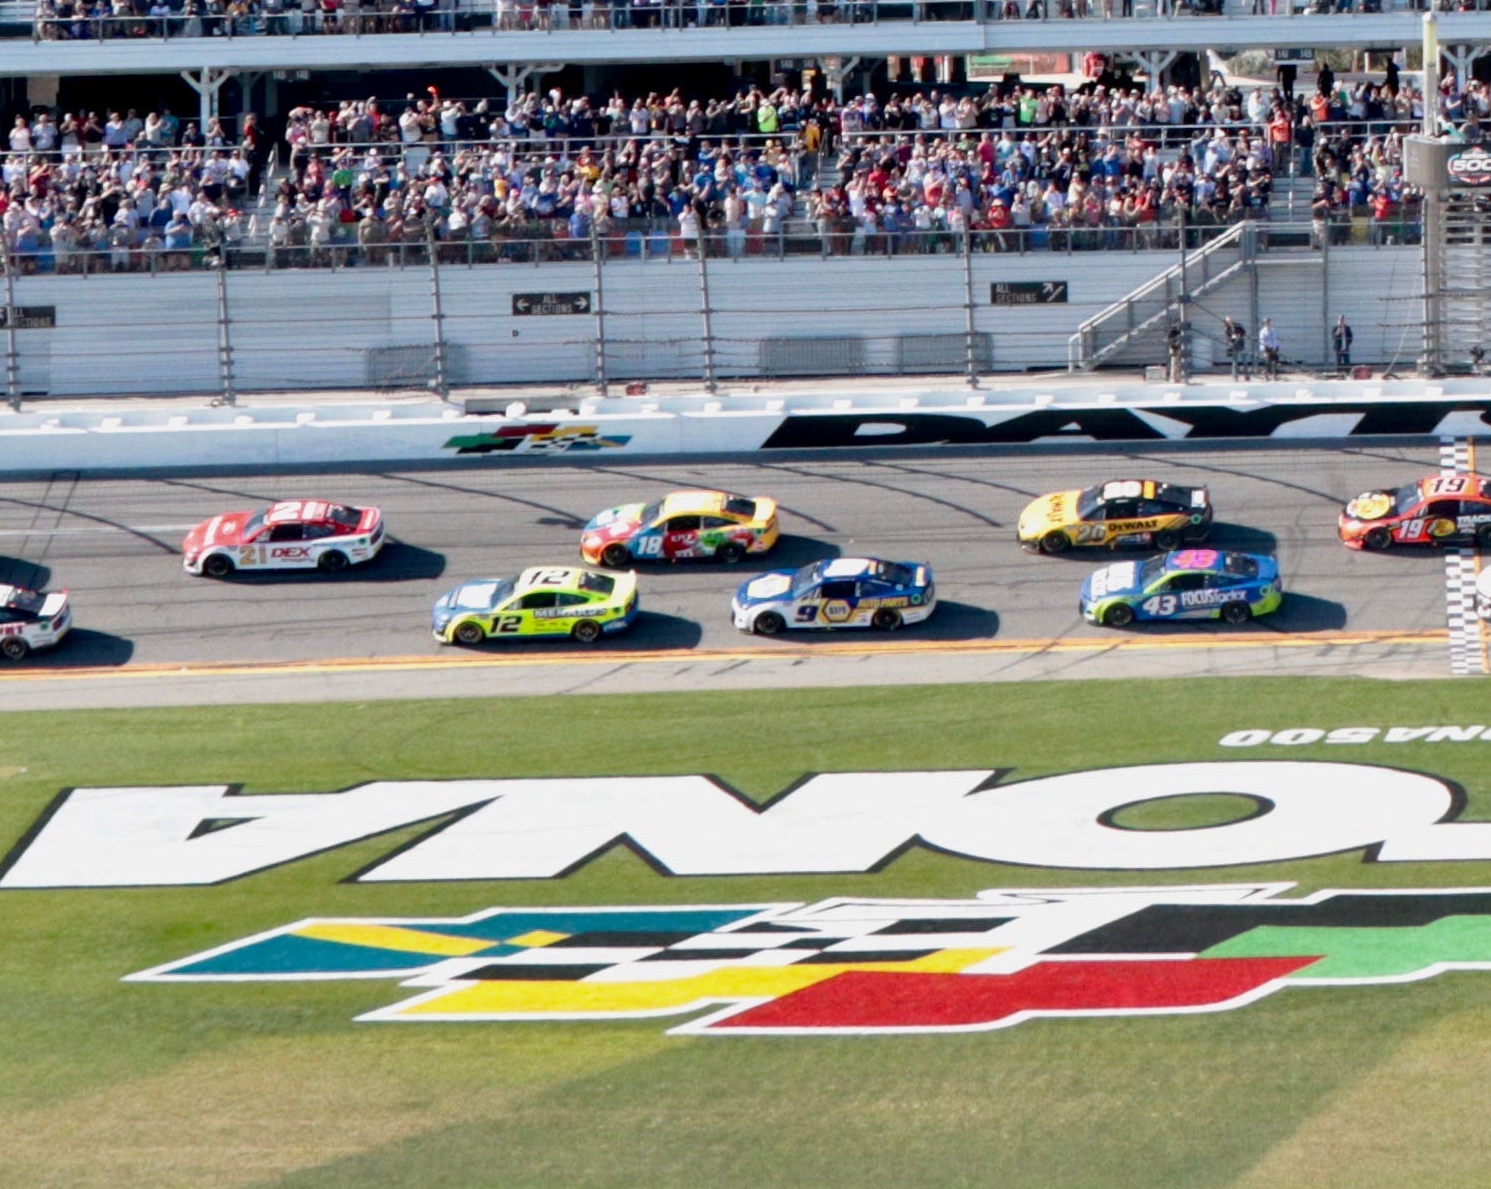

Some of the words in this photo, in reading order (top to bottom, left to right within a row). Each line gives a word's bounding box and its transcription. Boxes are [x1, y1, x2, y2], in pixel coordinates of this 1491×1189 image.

[995, 283, 1009, 293] ALL
[542, 293, 556, 303] ALL
[995, 293, 1037, 303] SECTIONS
[531, 303, 572, 314] SECTIONS
[1428, 477, 1468, 495] 19
[1398, 519, 1425, 539] 19
[270, 547, 312, 558] DEX
[636, 536, 663, 555] 18
[239, 545, 267, 566] 21
[528, 570, 570, 586] 12
[533, 607, 608, 621] MENARDS
[794, 605, 820, 623] 9
[1141, 595, 1177, 616] 43
[488, 616, 523, 634] 12
